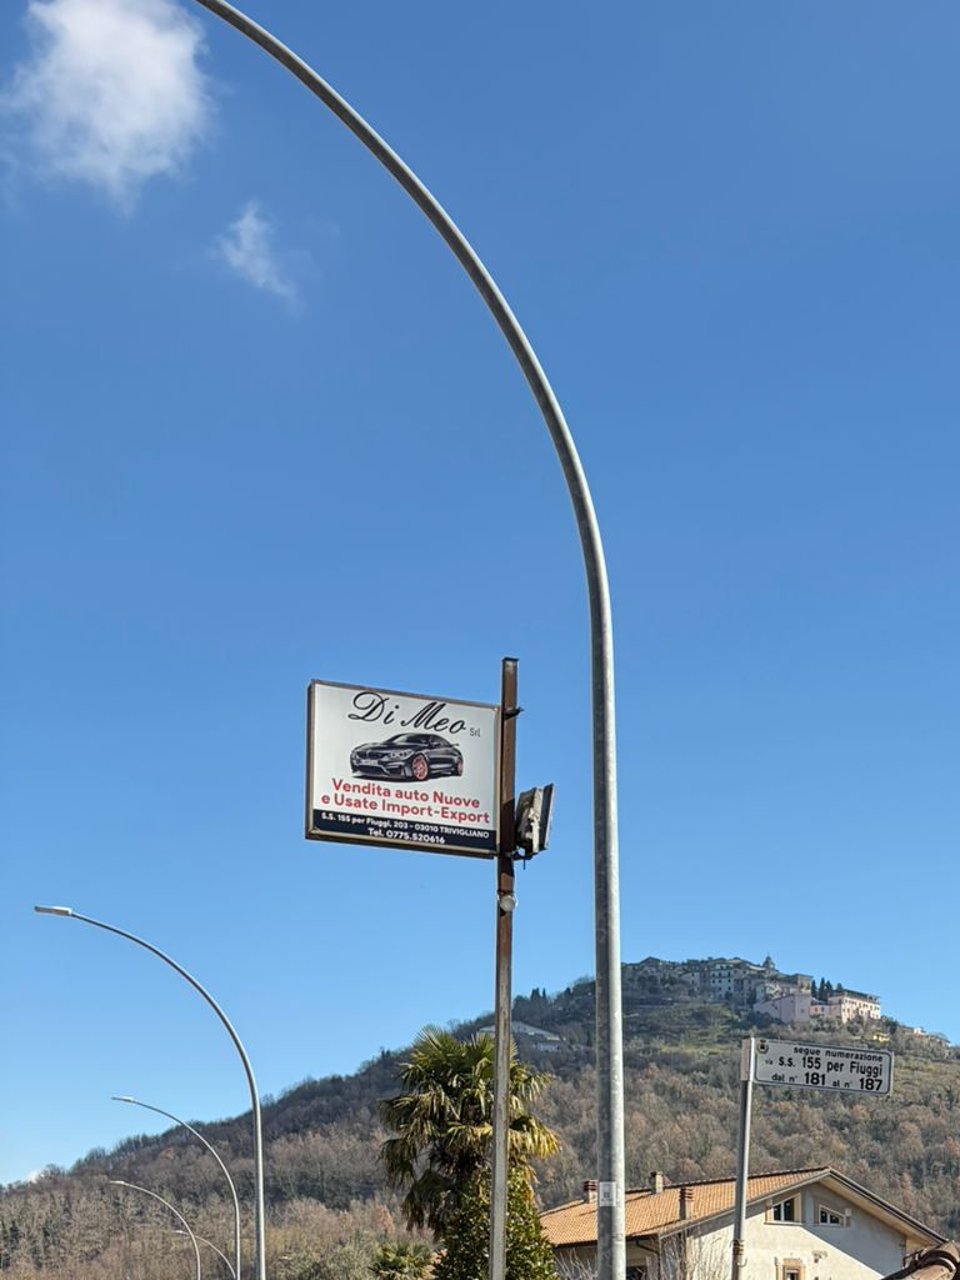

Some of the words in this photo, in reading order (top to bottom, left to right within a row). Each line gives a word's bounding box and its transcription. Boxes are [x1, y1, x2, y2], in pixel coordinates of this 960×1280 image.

[348, 691, 400, 726] Di
[400, 701, 466, 734] Meo
[469, 727, 481, 738] Srl
[332, 778, 391, 797] Vendita
[395, 787, 429, 803] auto
[433, 791, 480, 808] Nuove
[321, 794, 331, 804] e
[334, 793, 378, 811] Usate
[382, 800, 490, 824] Import-Export
[338, 814, 350, 822] 155
[351, 817, 365, 825] per
[393, 820, 408, 829] 203
[414, 823, 438, 832] 03010
[440, 826, 490, 839] TRIVIGLIANO
[368, 827, 384, 837] Tel.
[386, 830, 446, 844] 0775.520616
[794, 1046, 821, 1056] segue
[825, 1050, 883, 1062] numerazione
[778, 1056, 797, 1068] S.S.
[802, 1056, 821, 1070] 155
[827, 1061, 844, 1073] per
[850, 1060, 883, 1079] Fiuggi
[771, 1072, 785, 1082] dal
[804, 1071, 825, 1086] 181
[859, 1077, 883, 1091] 187
